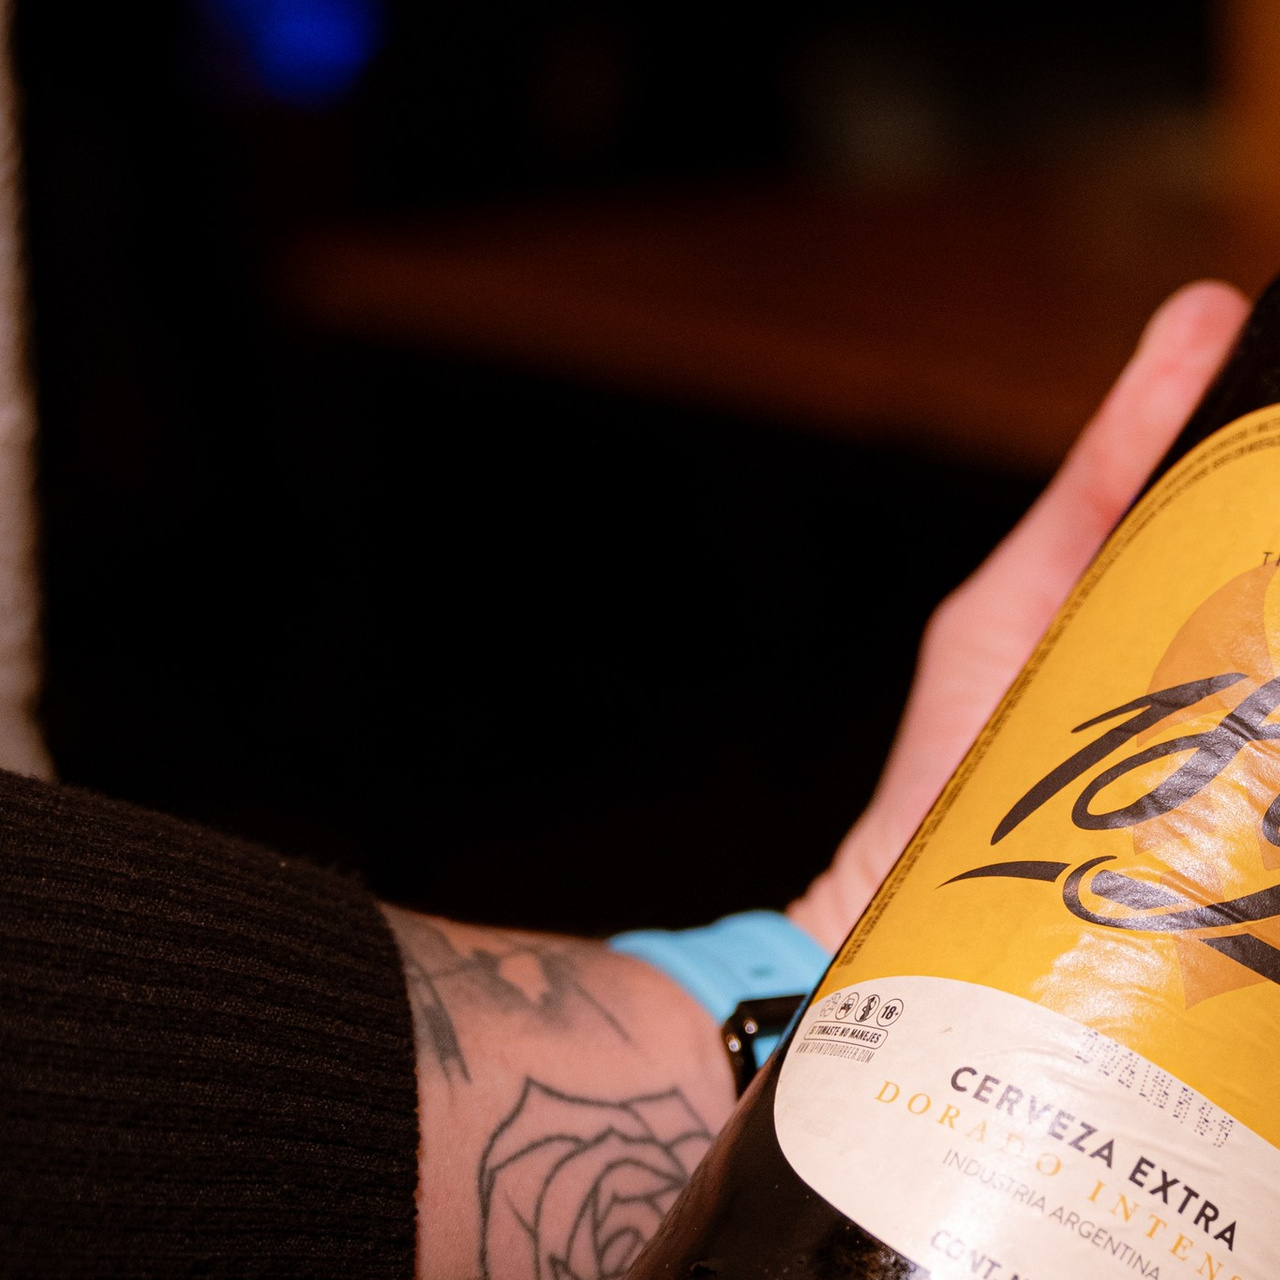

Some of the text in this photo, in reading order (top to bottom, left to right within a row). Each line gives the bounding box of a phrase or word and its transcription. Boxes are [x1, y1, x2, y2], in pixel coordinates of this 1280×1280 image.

[880, 1004, 900, 1020] 18+
[814, 1024, 841, 1037] TOMASTE
[838, 1026, 850, 1038] NO
[849, 1027, 882, 1044] MANEJES
[950, 1066, 1115, 1169] CERVEZA
[1128, 1156, 1237, 1251] EXTRA
[942, 1148, 1047, 1214] INDUSTRIA
